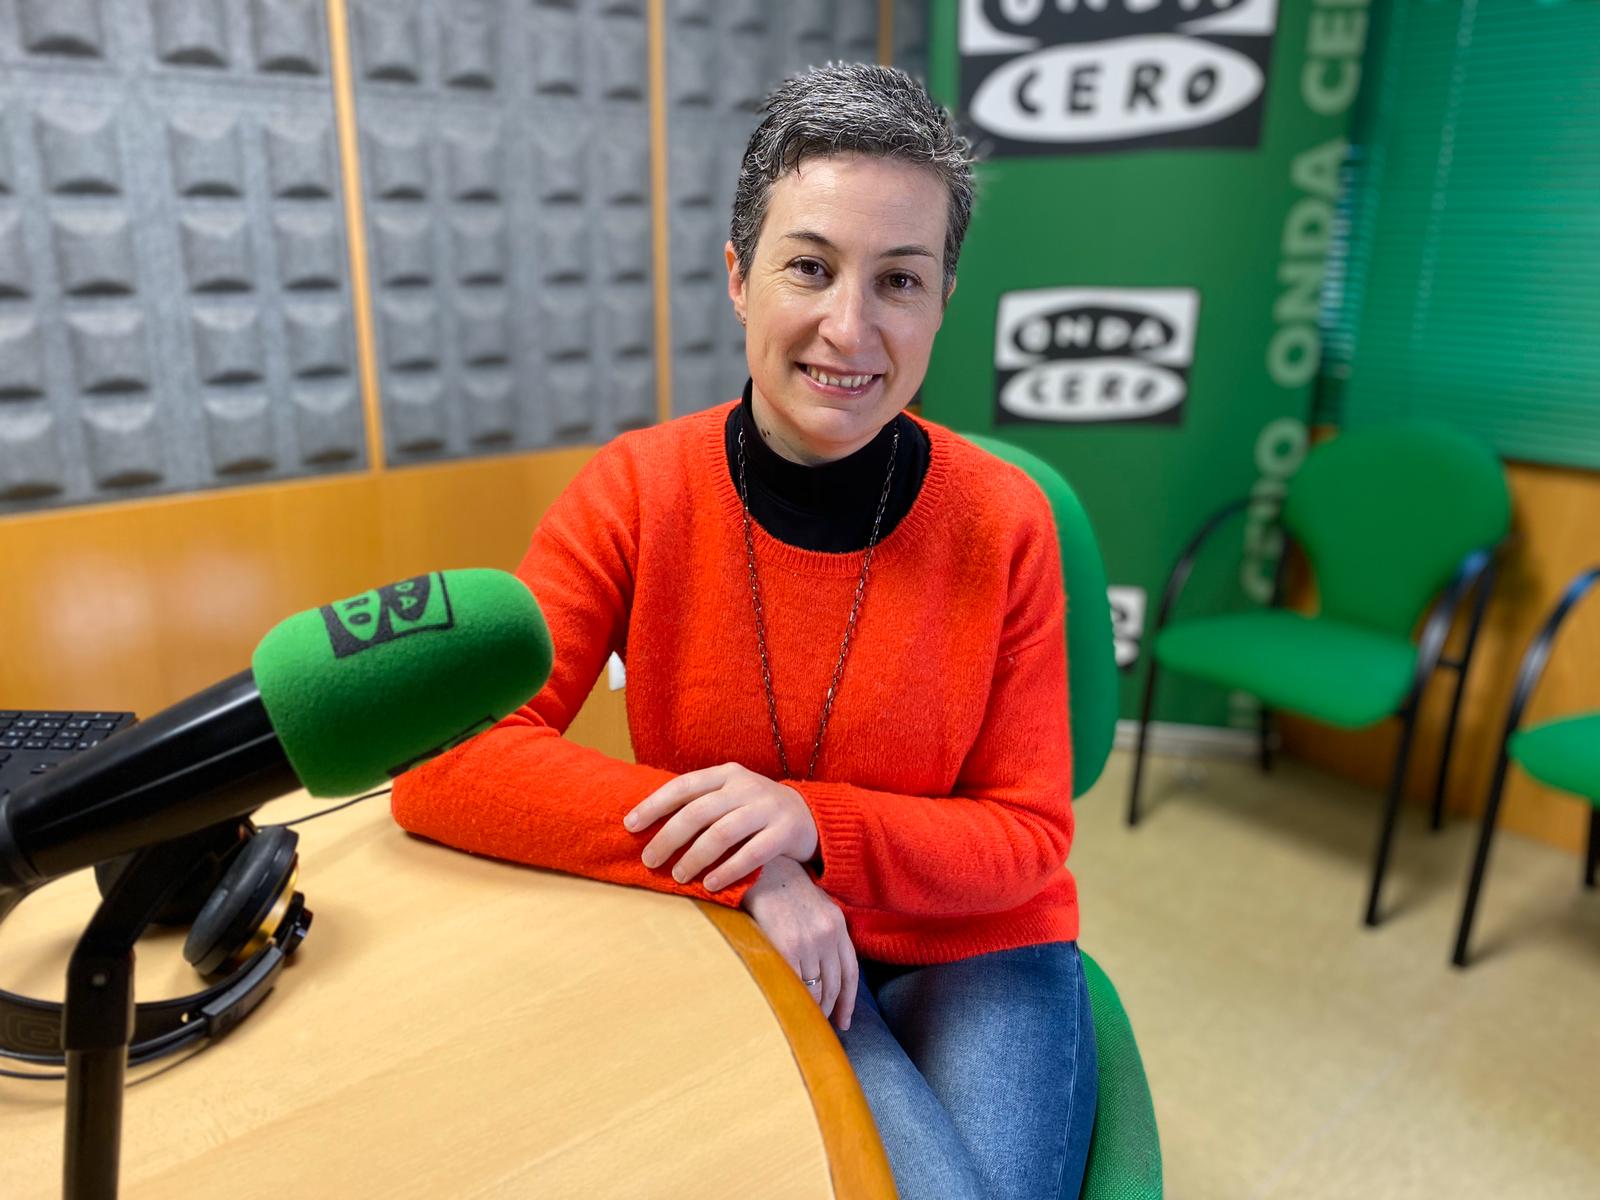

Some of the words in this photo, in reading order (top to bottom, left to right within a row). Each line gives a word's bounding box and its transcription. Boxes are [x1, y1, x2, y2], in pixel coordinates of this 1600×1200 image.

[1301, 0, 1369, 115] CE
[1012, 62, 1220, 118] CERO
[1266, 138, 1346, 387] ONDA
[1018, 314, 1167, 353] ONDA
[1028, 372, 1157, 405] CERO
